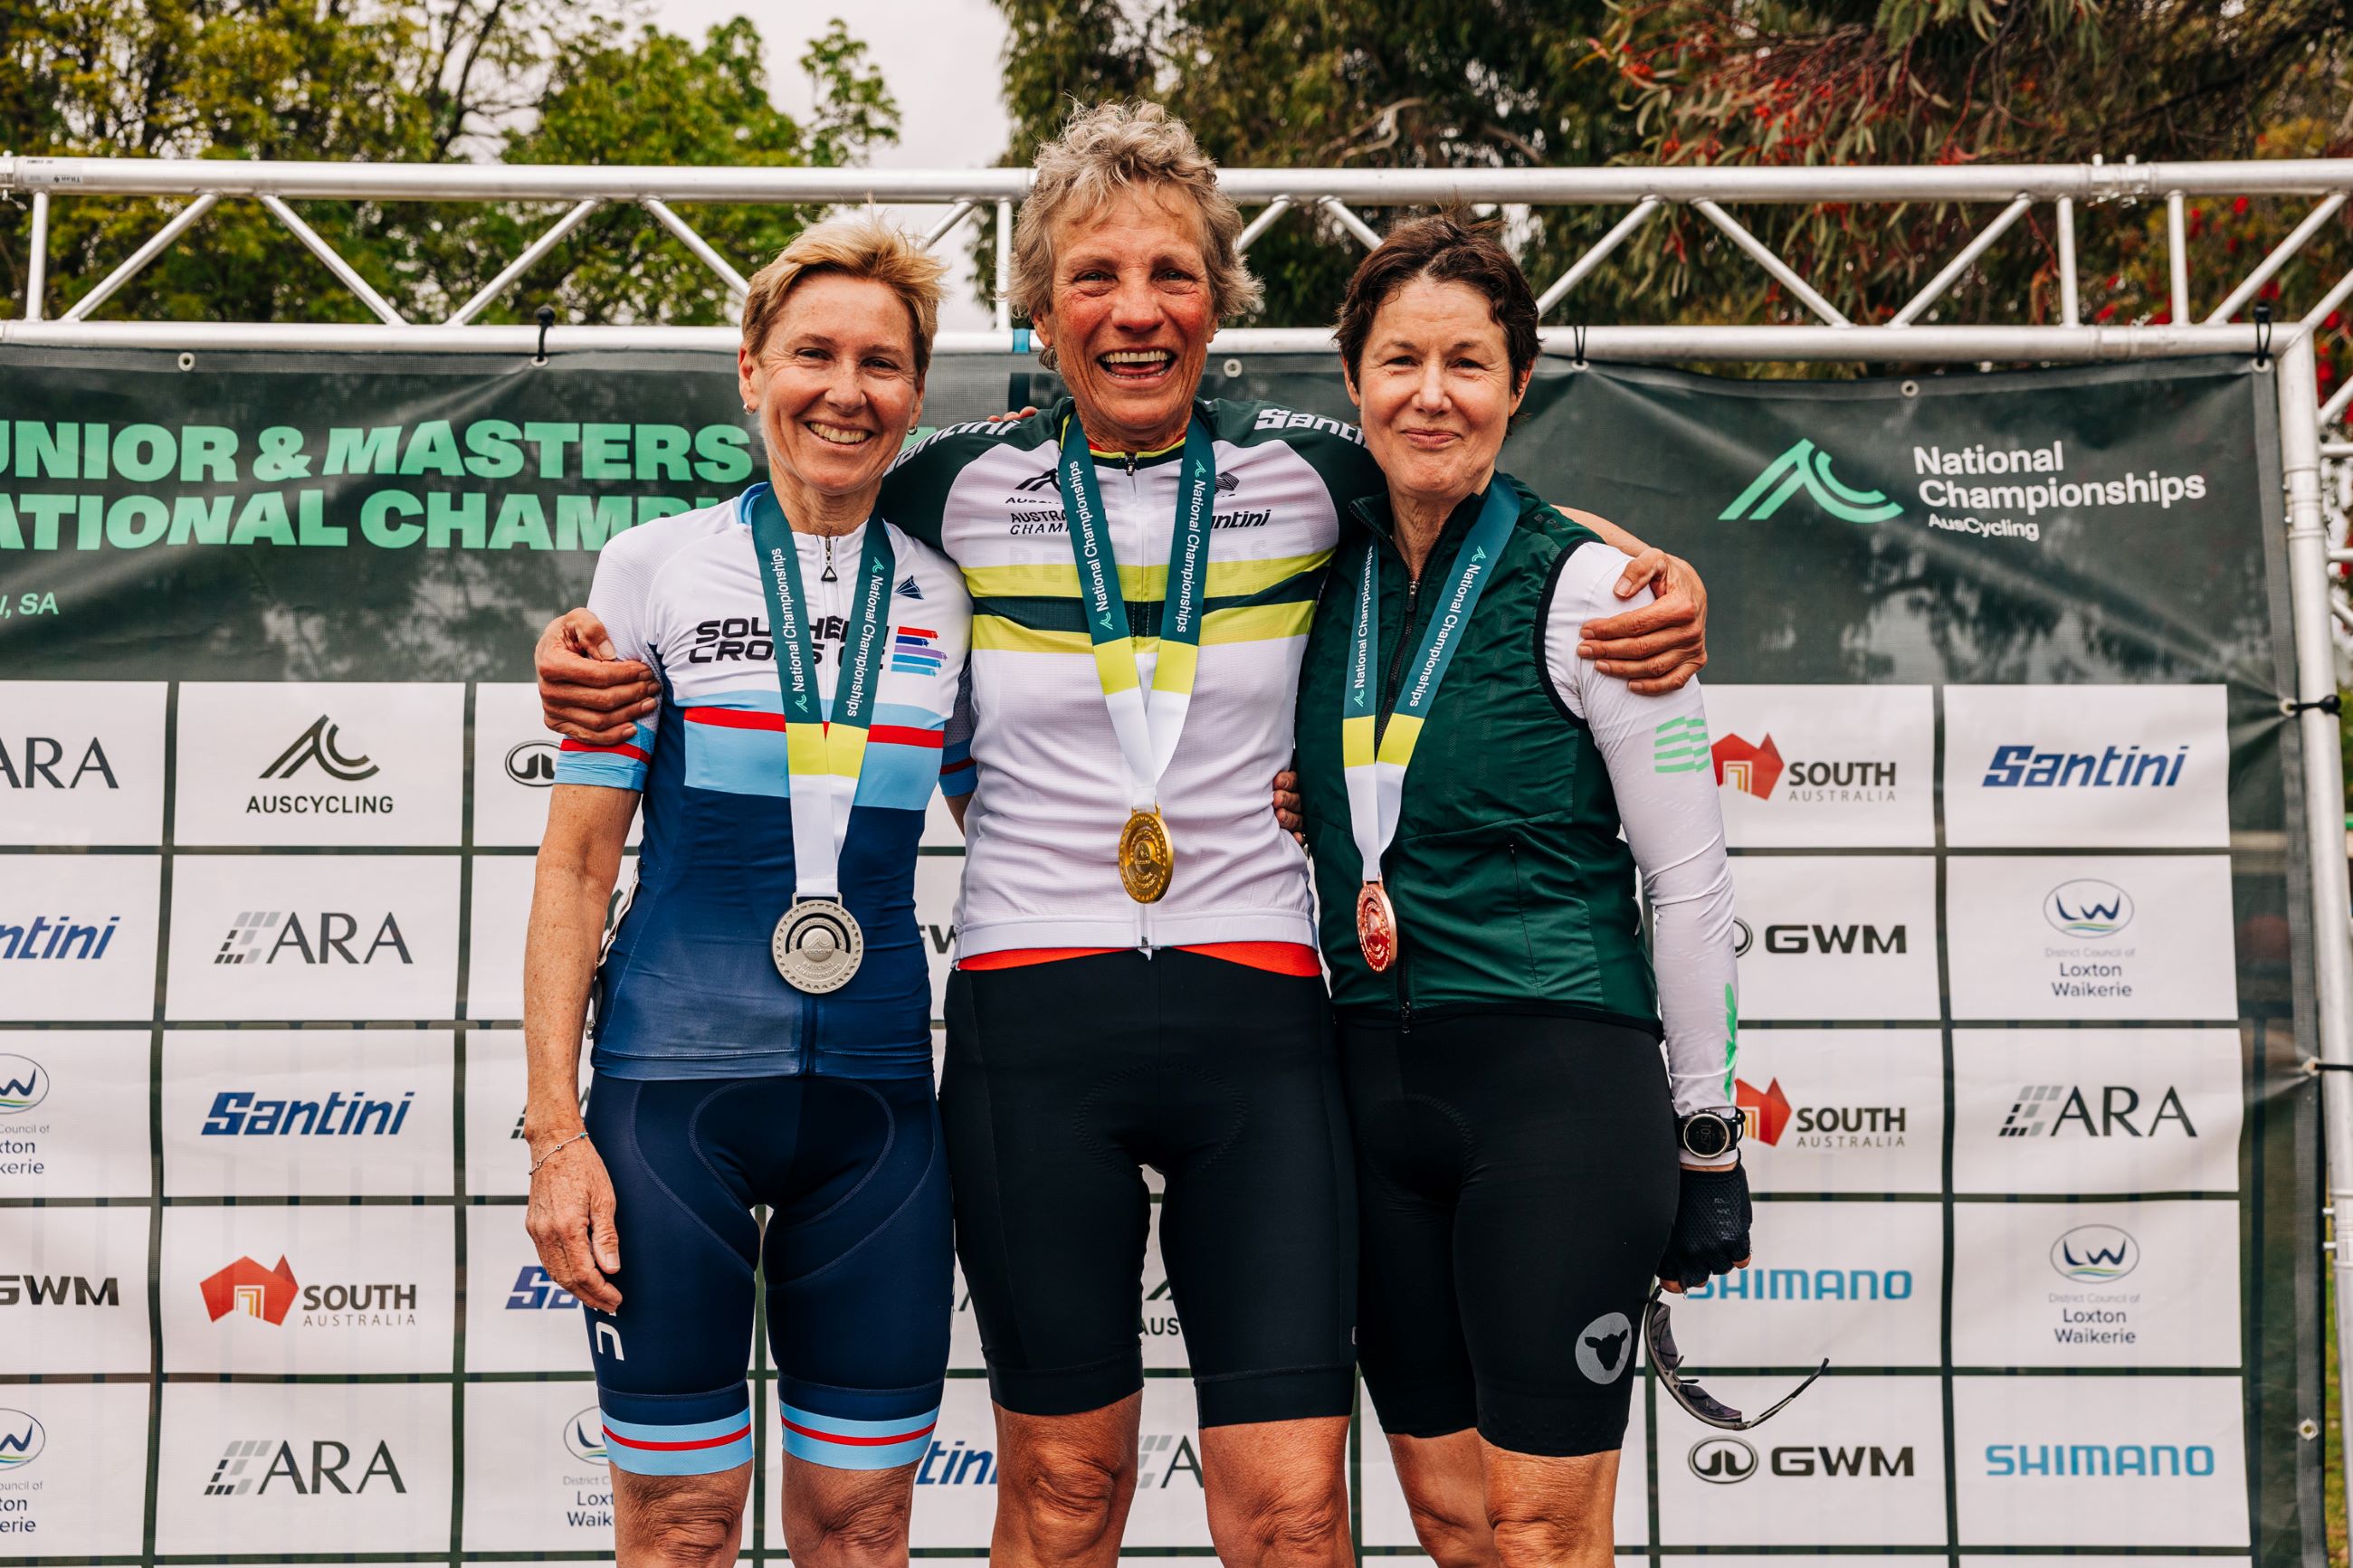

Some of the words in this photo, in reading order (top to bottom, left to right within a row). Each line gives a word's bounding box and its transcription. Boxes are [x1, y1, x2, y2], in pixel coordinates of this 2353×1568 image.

[0, 420, 238, 481] NIOR
[253, 426, 310, 481] &
[323, 419, 753, 483] MASTERS
[1912, 440, 2064, 475] National
[1069, 461, 1098, 558] Championships
[1188, 479, 1206, 532] National
[1918, 470, 2206, 517] Championships
[362, 490, 719, 551] CHAM
[1929, 513, 2040, 542] AusCycling
[19, 592, 60, 615] SA
[771, 547, 797, 639] Championships
[864, 575, 884, 623] National
[1087, 559, 1110, 613] National
[1176, 533, 1201, 633] Championships
[1358, 545, 1374, 637] Championships
[1449, 563, 1481, 613] National
[786, 641, 805, 692] National
[846, 623, 876, 717] Championships
[1354, 639, 1367, 689] National
[1409, 613, 1459, 708] Championships
[1788, 762, 1897, 787] SOUTH
[1982, 746, 2189, 787] Santini
[246, 795, 393, 813] AUSCYCLING
[1788, 790, 1896, 802] AUSTRALIA
[266, 912, 414, 965] ARA
[1765, 925, 1907, 955] GWM
[2052, 982, 2132, 997] Waikerie
[2060, 962, 2122, 977] Loxton
[39, 1124, 50, 1134] of
[201, 1091, 414, 1136] Santini
[1796, 1107, 1906, 1133] SOUTH
[2050, 1085, 2198, 1138] ARA
[1797, 1136, 1905, 1148] AUSTRALIA
[303, 1284, 416, 1311] SOUTH
[2063, 1308, 2127, 1324] Loxton
[303, 1314, 416, 1326] AUSTRALIA
[2053, 1328, 2137, 1344] Waikerie
[257, 1440, 407, 1495] ARA
[1771, 1446, 1915, 1478] GWM
[1986, 1445, 2215, 1477] SHIMANO
